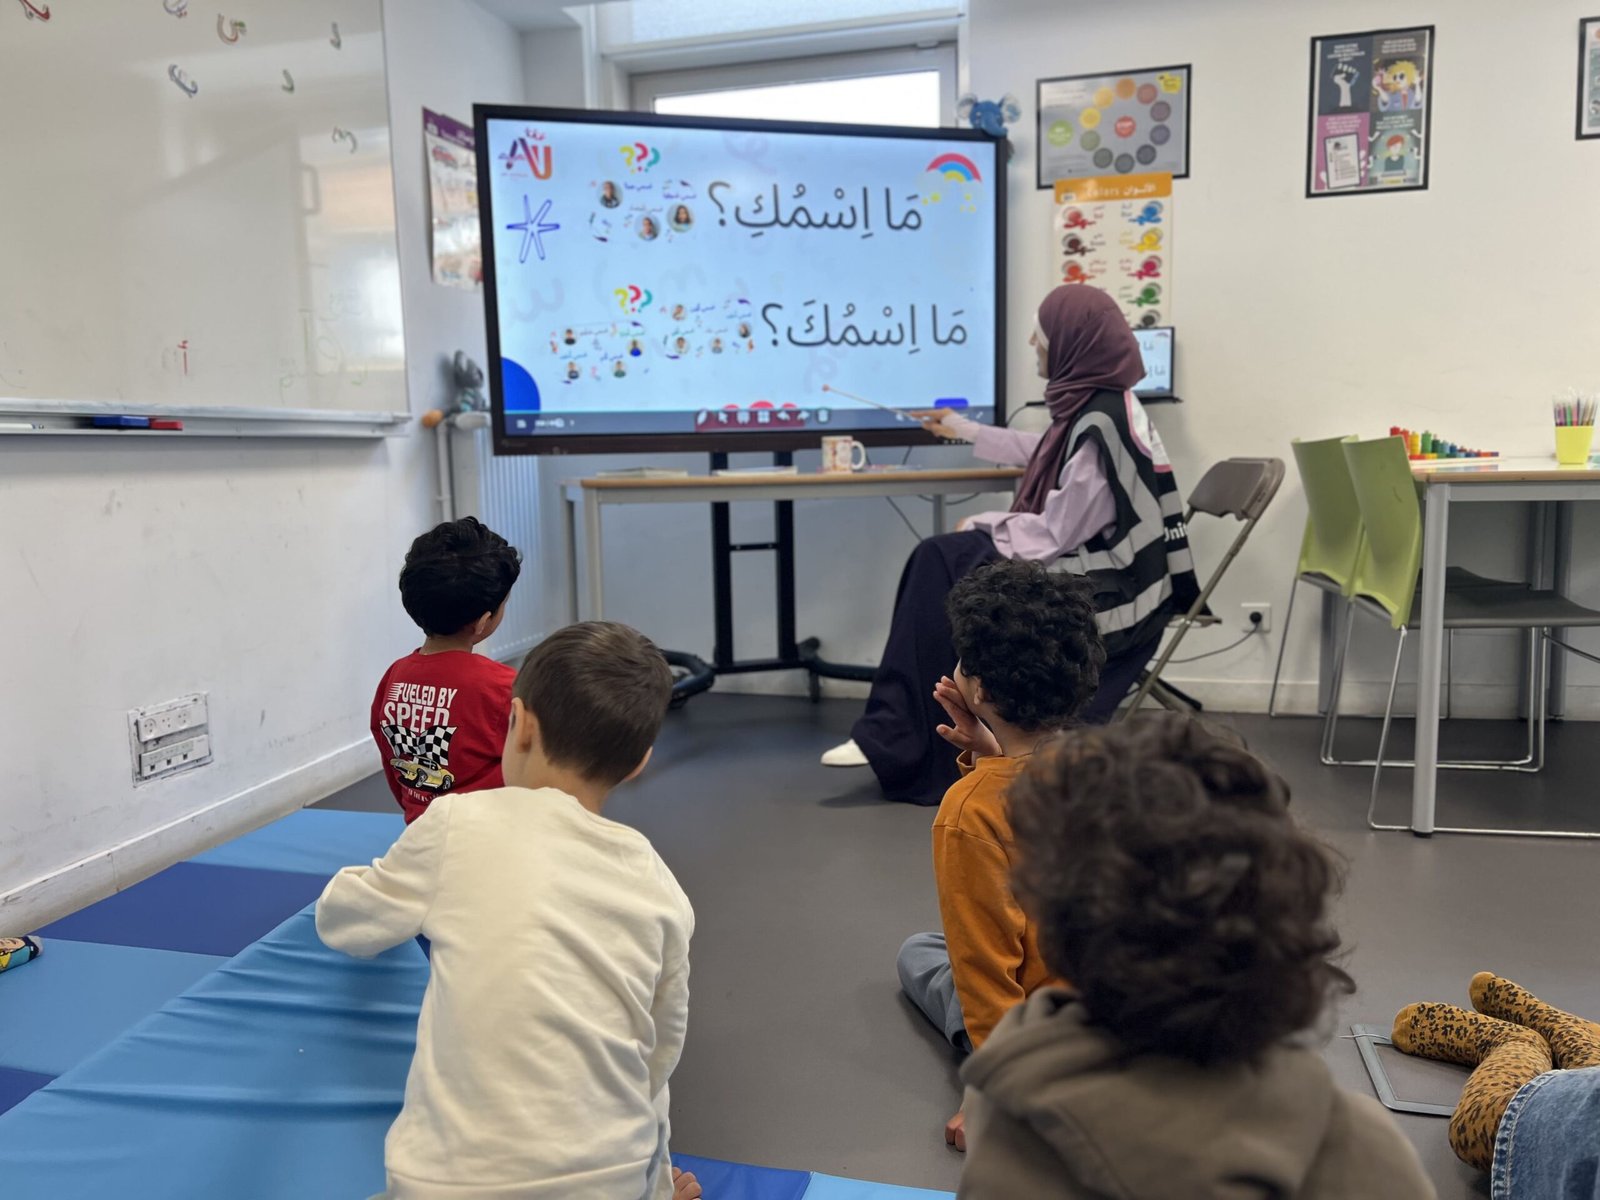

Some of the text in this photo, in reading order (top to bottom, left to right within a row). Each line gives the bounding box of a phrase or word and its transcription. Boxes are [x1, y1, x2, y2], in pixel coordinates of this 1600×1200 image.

[389, 682, 458, 709] FUELED BY
[381, 701, 450, 733] SPEED
